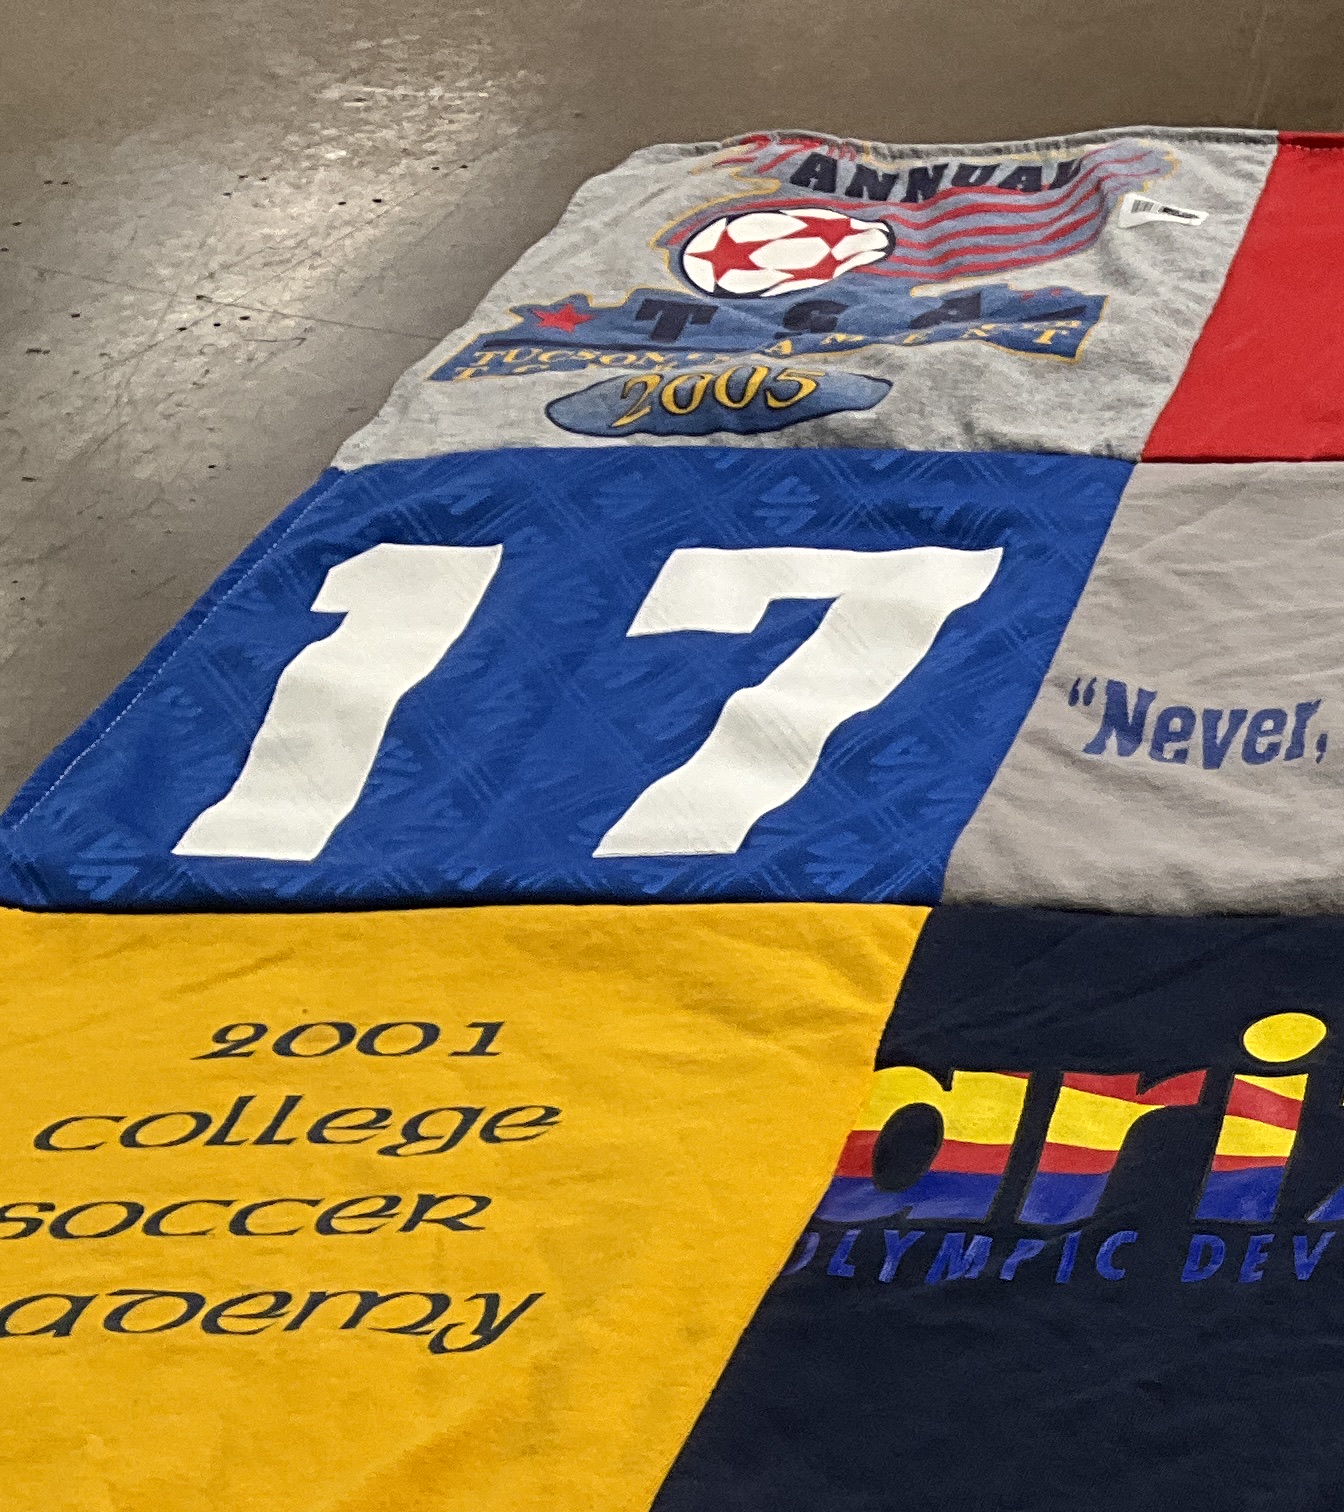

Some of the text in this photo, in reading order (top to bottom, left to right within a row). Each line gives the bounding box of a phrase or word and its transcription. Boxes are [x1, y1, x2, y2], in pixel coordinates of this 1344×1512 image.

[610, 365, 826, 428] 2005
[170, 542, 1003, 861] 17
[190, 1019, 506, 1060] 2001
[32, 1094, 564, 1157] college
